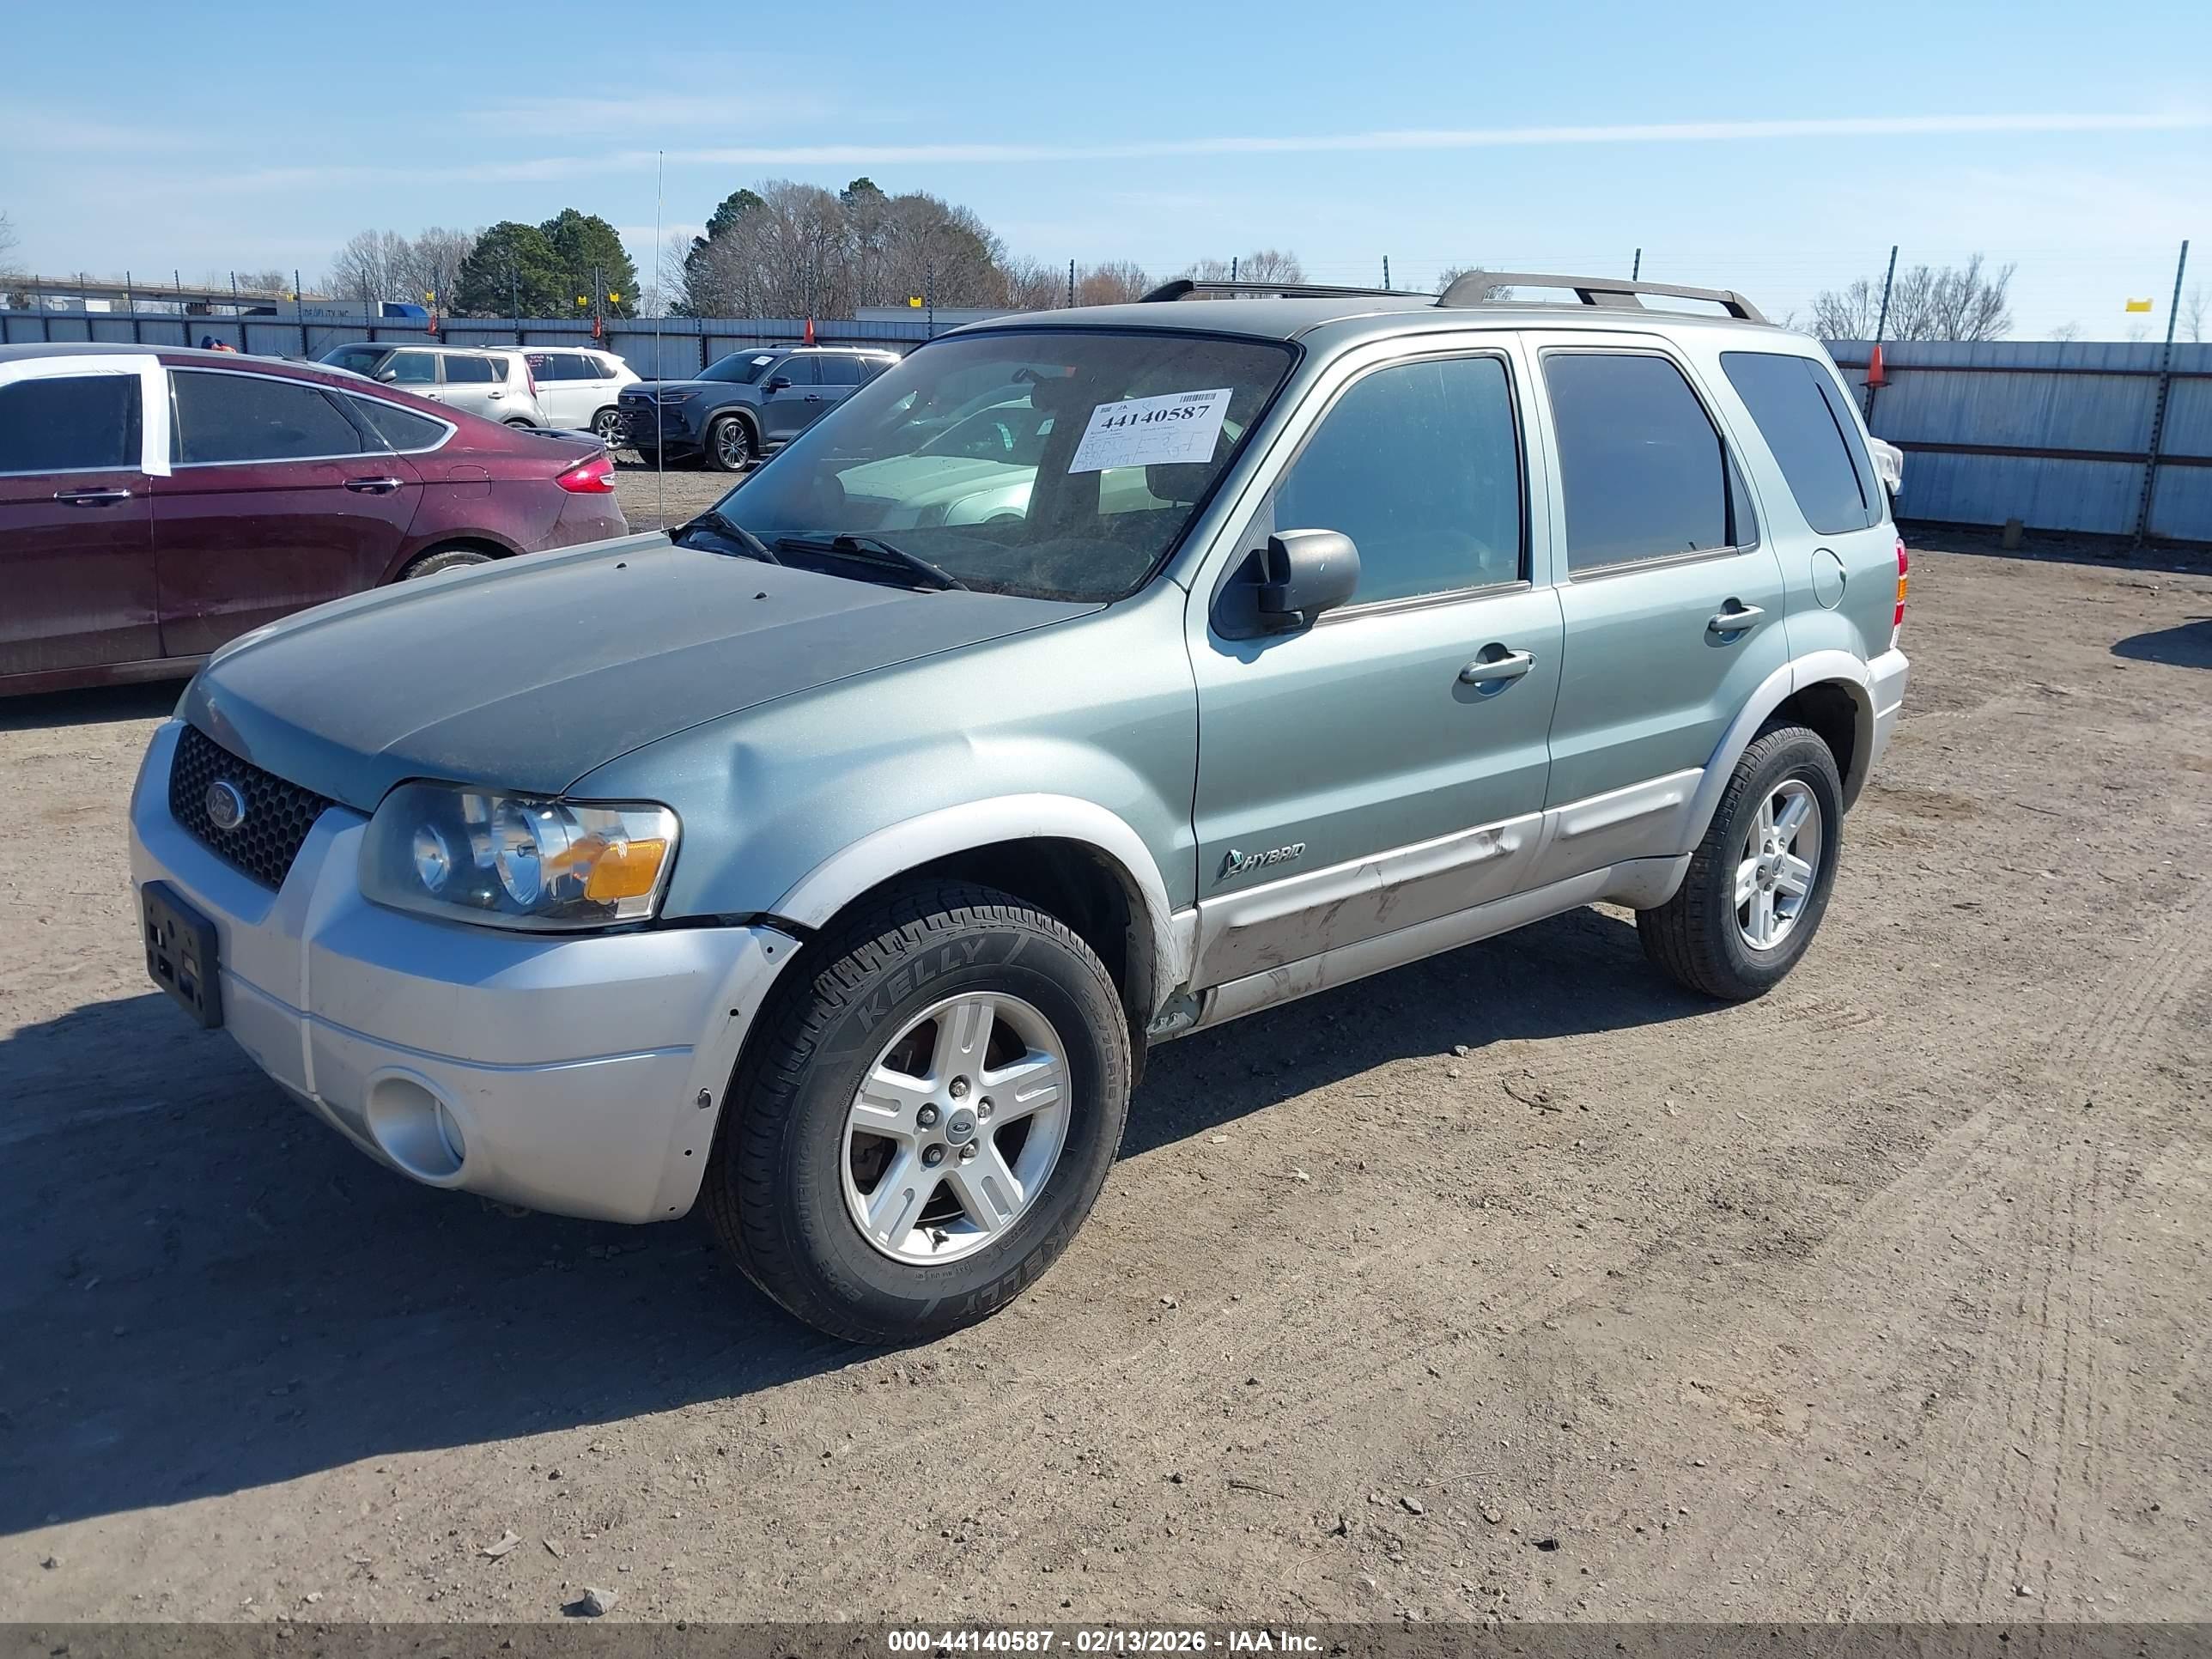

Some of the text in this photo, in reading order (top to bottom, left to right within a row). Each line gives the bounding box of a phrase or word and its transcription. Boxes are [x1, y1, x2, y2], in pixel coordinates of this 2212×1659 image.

[1100, 405, 1211, 429] 44140587
[211, 789, 234, 821] Ford
[1242, 842, 1306, 871] HYBRID
[859, 937, 987, 1033] KELLY
[952, 1221, 1069, 1321] KELLY
